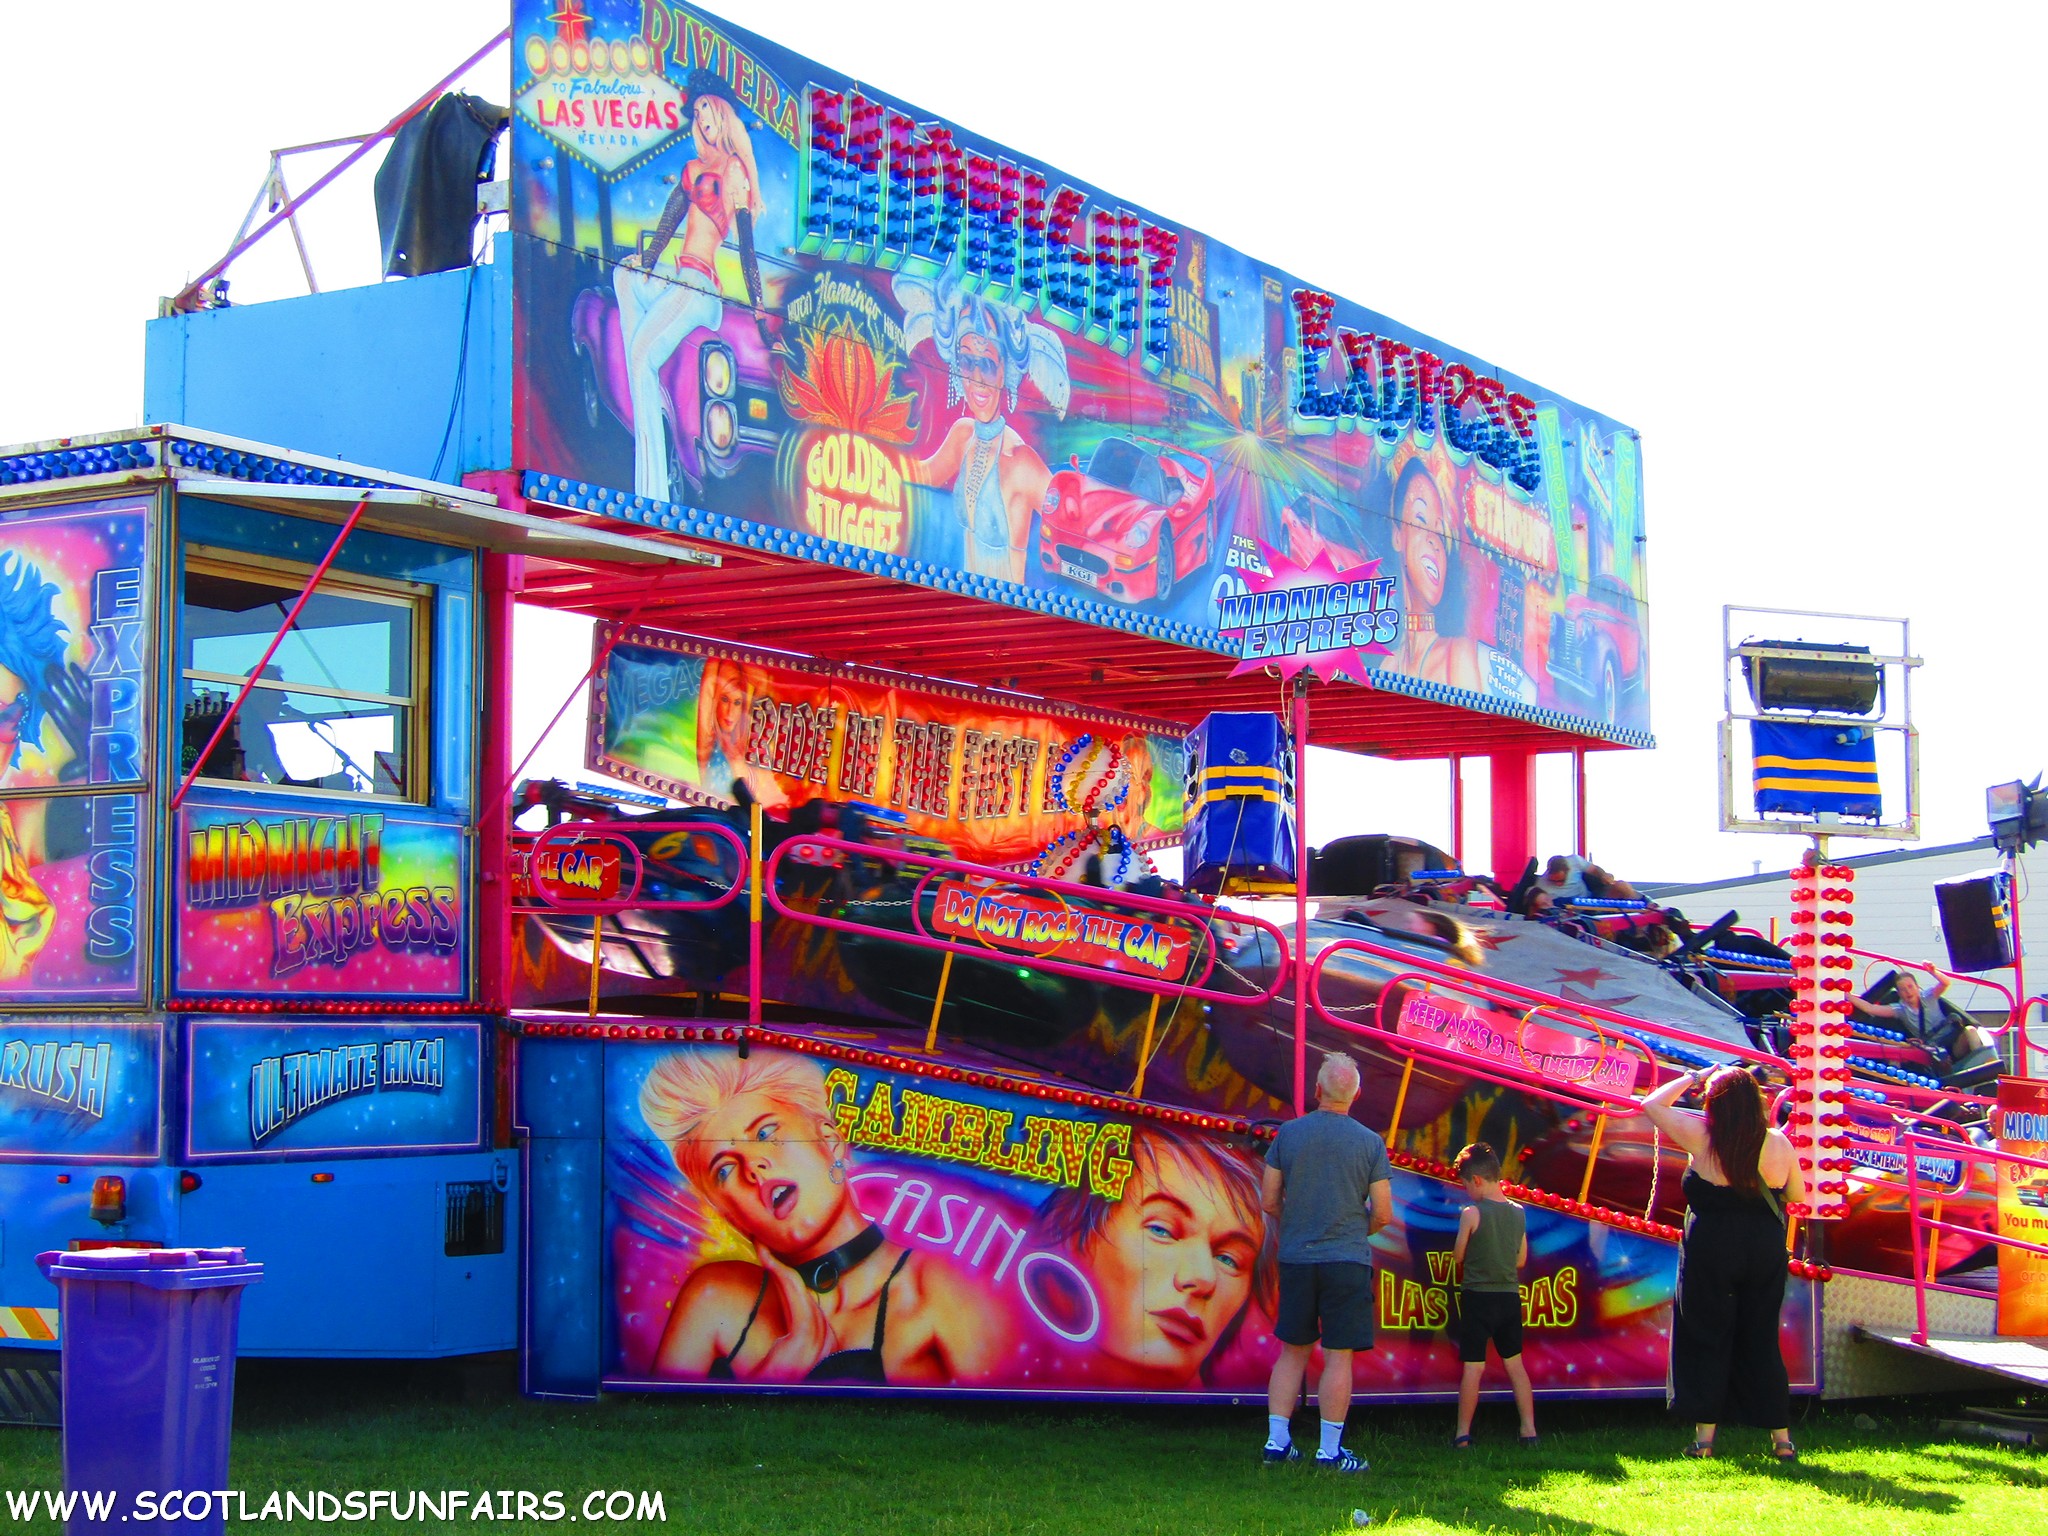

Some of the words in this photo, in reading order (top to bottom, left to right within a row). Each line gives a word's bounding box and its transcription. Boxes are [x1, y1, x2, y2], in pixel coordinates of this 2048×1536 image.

[552, 82, 567, 93] TO
[569, 77, 646, 100] Fabulous
[641, 0, 801, 151] RIVIERA
[537, 99, 587, 127] LAS
[592, 99, 679, 130] VEGAS
[578, 133, 639, 147] NEVADA
[800, 81, 1180, 376] MIDNIGHT
[806, 433, 902, 508] GOLDEN
[806, 486, 902, 554] NUGGET
[1233, 535, 1256, 550] THE
[1474, 484, 1549, 567] STARDUST
[1226, 548, 1262, 572] BIG
[1219, 576, 1397, 632] MIDNIGHT
[1241, 610, 1399, 661] EXPRESS
[1488, 672, 1523, 701] NIGHT
[1489, 650, 1524, 677] ENTER
[1495, 664, 1518, 686] THE
[88, 567, 146, 959] EXPRESS
[746, 697, 837, 785] RIDE
[839, 711, 885, 799] IN
[892, 718, 956, 820] THE
[958, 722, 1039, 822] FAST
[189, 813, 384, 903] MIDNIGHT
[561, 852, 604, 890] CAR
[274, 886, 459, 976] Express
[943, 889, 976, 926] DO
[976, 900, 1022, 939] NOT
[1022, 911, 1085, 943] ROCK
[1084, 915, 1125, 951] THE
[1123, 925, 1174, 971] CAR
[0, 1040, 111, 1118] RUSH
[1405, 999, 1446, 1031] KEEP
[1443, 1013, 1491, 1050] ARMS
[1488, 1034, 1504, 1057] &
[1503, 1042, 1543, 1070] LEGS
[1543, 1056, 1594, 1080] INSIDE
[1592, 1058, 1632, 1088] CAR
[251, 1043, 378, 1142] ULTIMATE
[383, 1037, 444, 1088] HIGH
[824, 1067, 1134, 1201] GAMBLING
[2004, 1212, 2028, 1228] You
[847, 1172, 1101, 1343] CASINO
[1381, 1269, 1448, 1330] LAS
